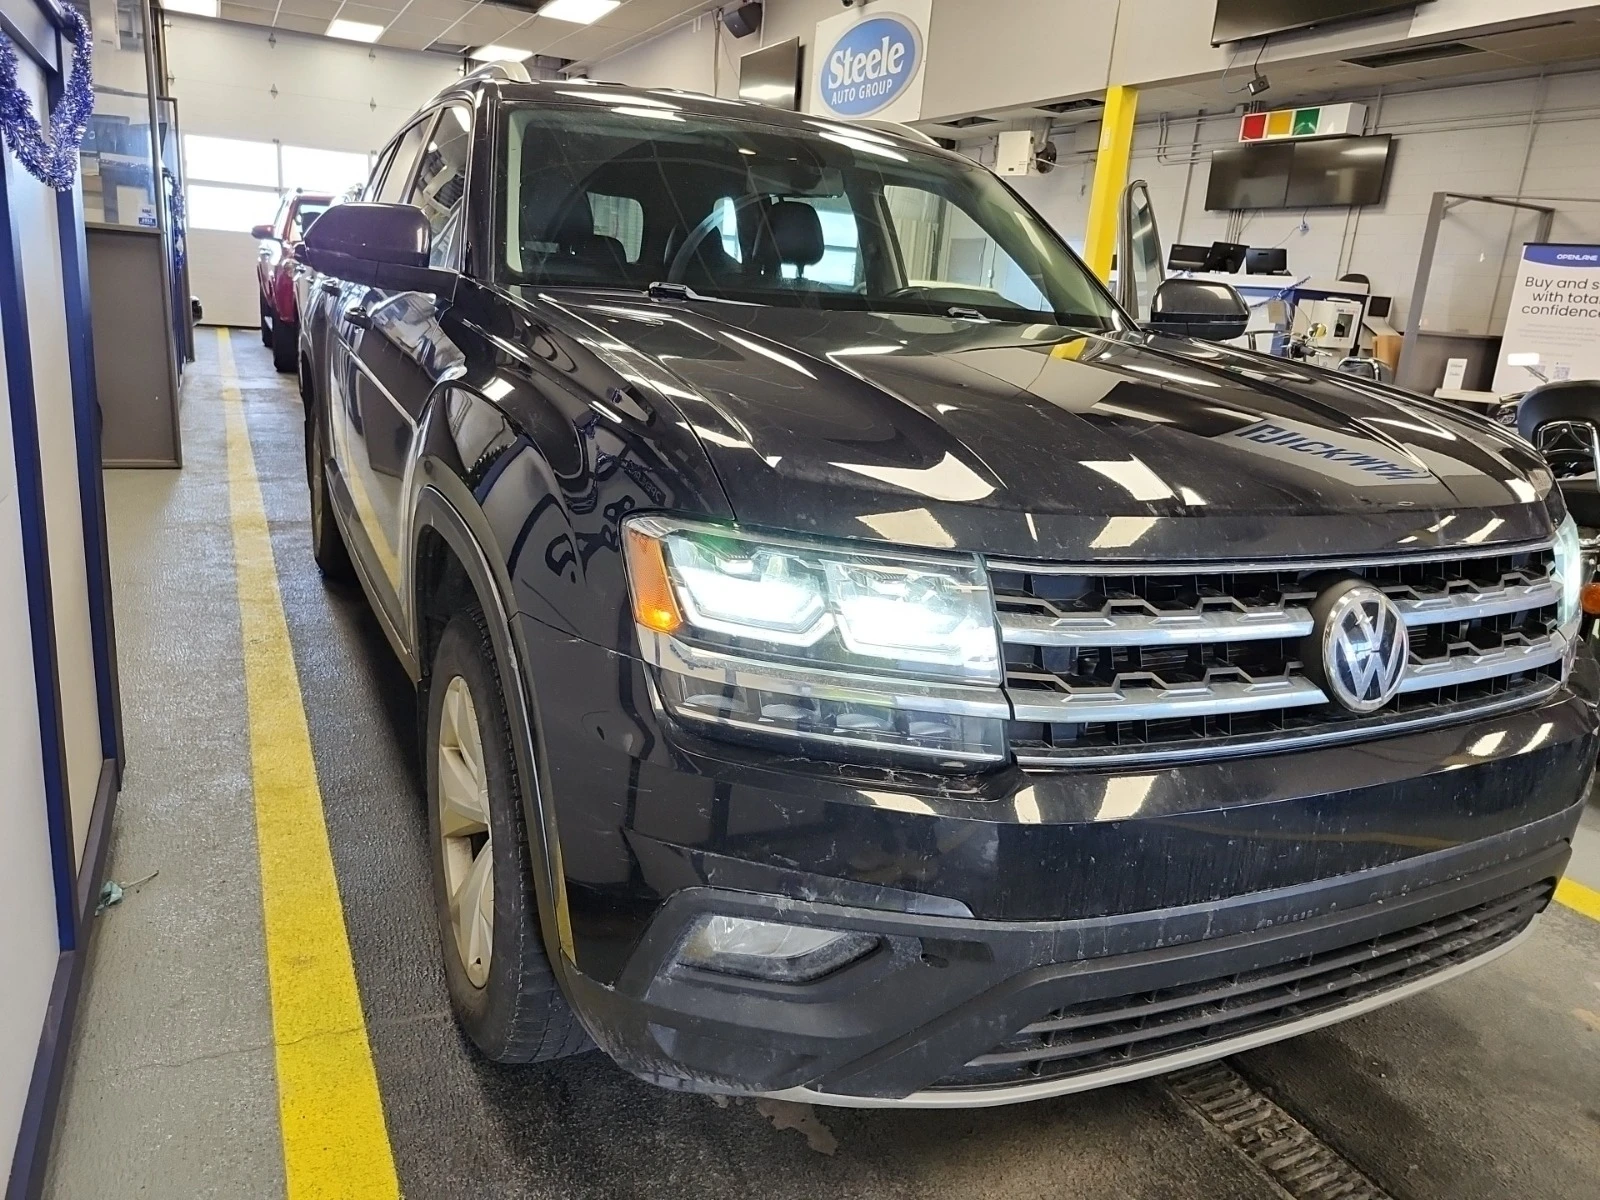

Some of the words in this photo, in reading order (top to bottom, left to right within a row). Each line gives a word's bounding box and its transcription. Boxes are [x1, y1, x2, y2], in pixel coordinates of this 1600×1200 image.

[828, 35, 905, 89] Steele
[831, 87, 856, 106] AUTO
[858, 78, 893, 99] GROUP
[1556, 253, 1598, 261] OPENLANE
[1525, 276, 1554, 291] Buy
[1556, 278, 1589, 290] and
[1532, 290, 1564, 303] with
[1568, 292, 1600, 305] tota
[1521, 304, 1600, 318] confidenc
